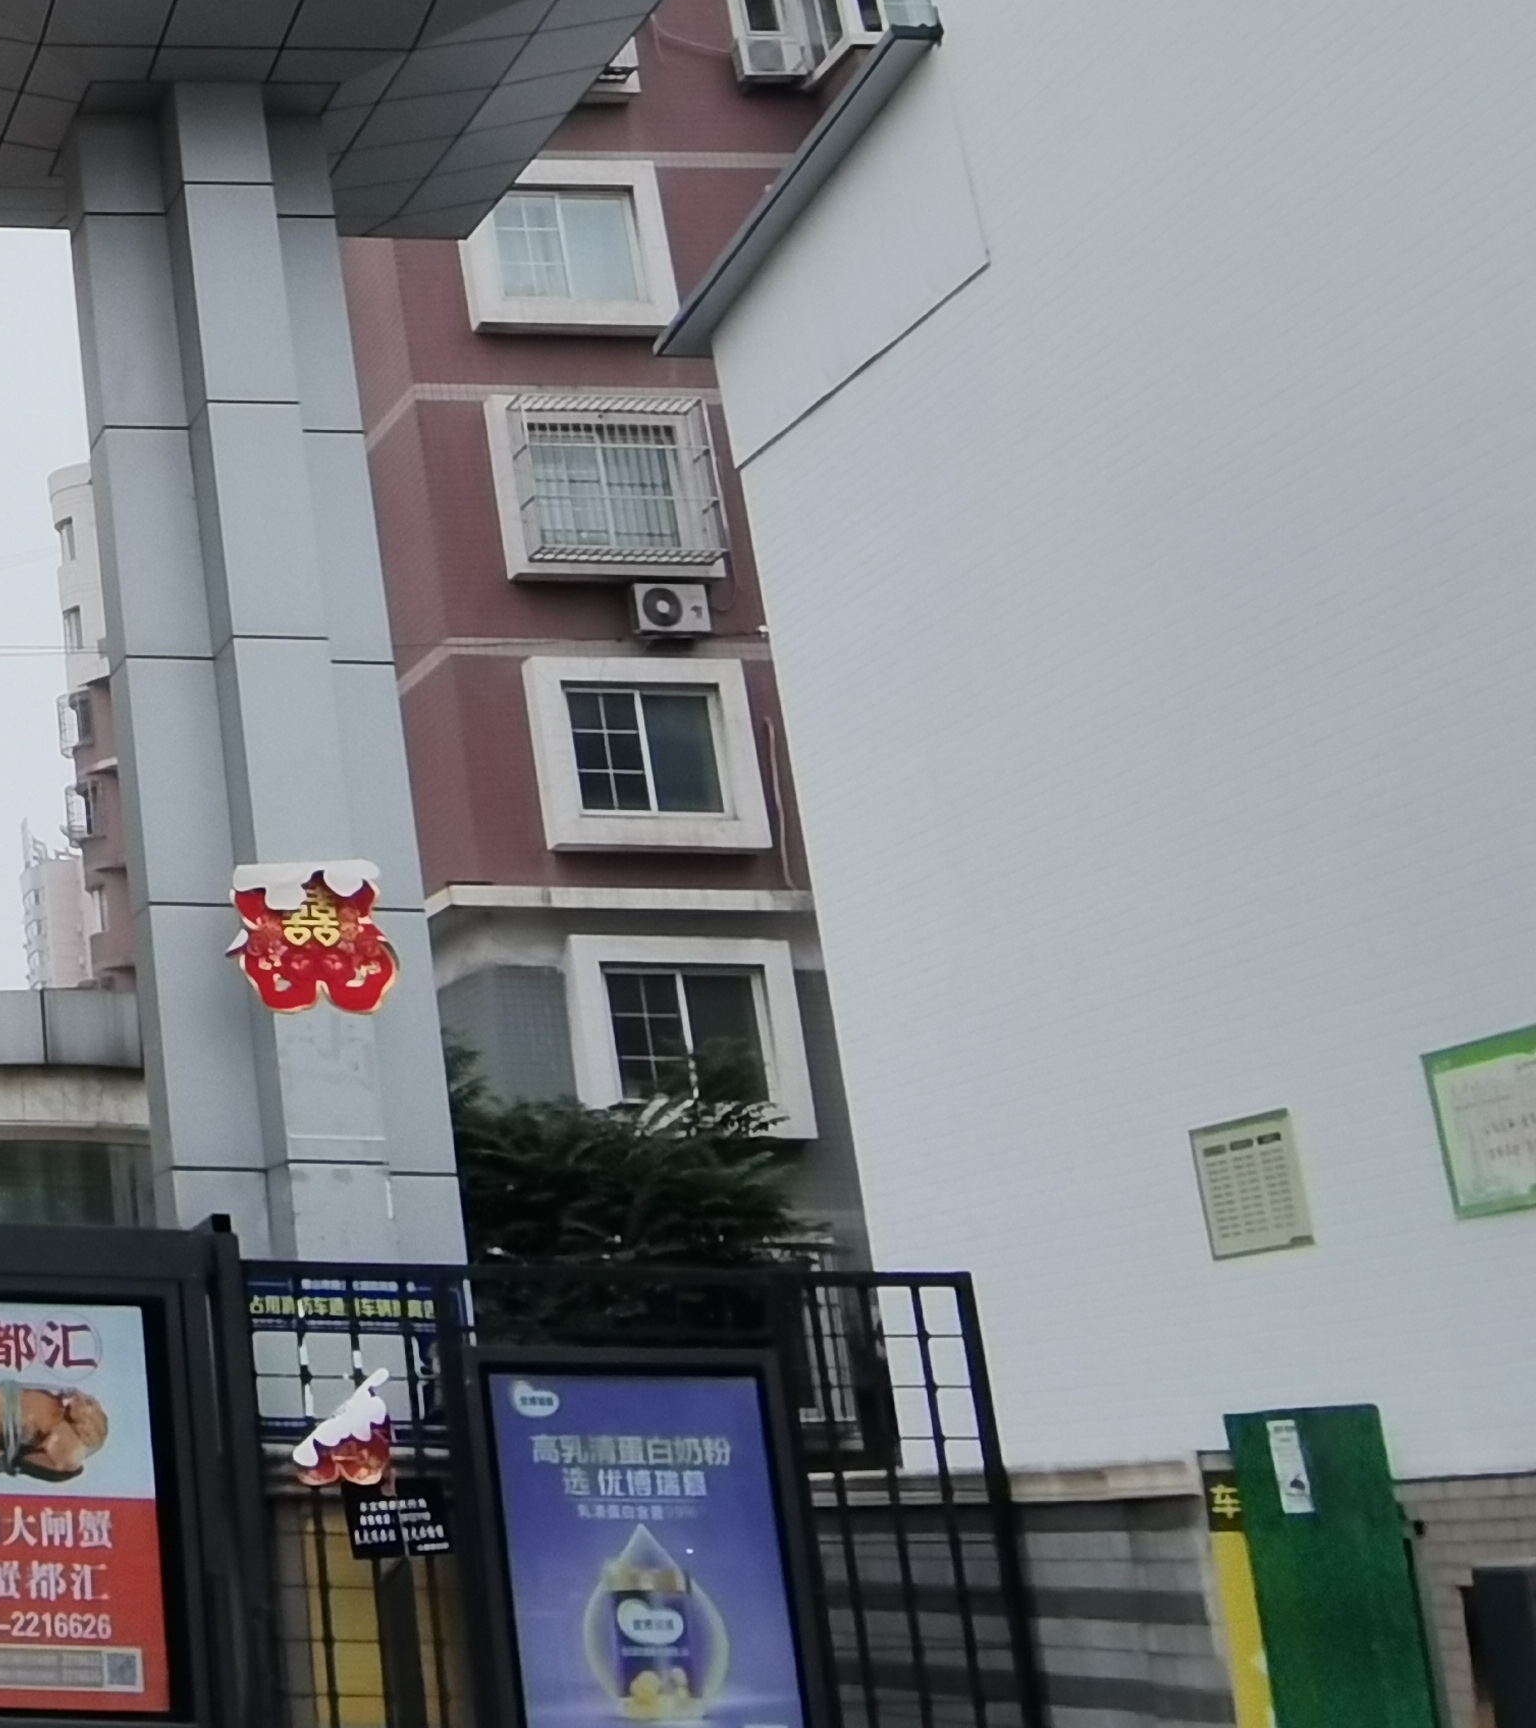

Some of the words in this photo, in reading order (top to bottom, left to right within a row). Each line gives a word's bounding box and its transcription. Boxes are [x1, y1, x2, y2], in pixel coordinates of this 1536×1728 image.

[530, 1434, 731, 1466] 高乳清蛋白奶粉
